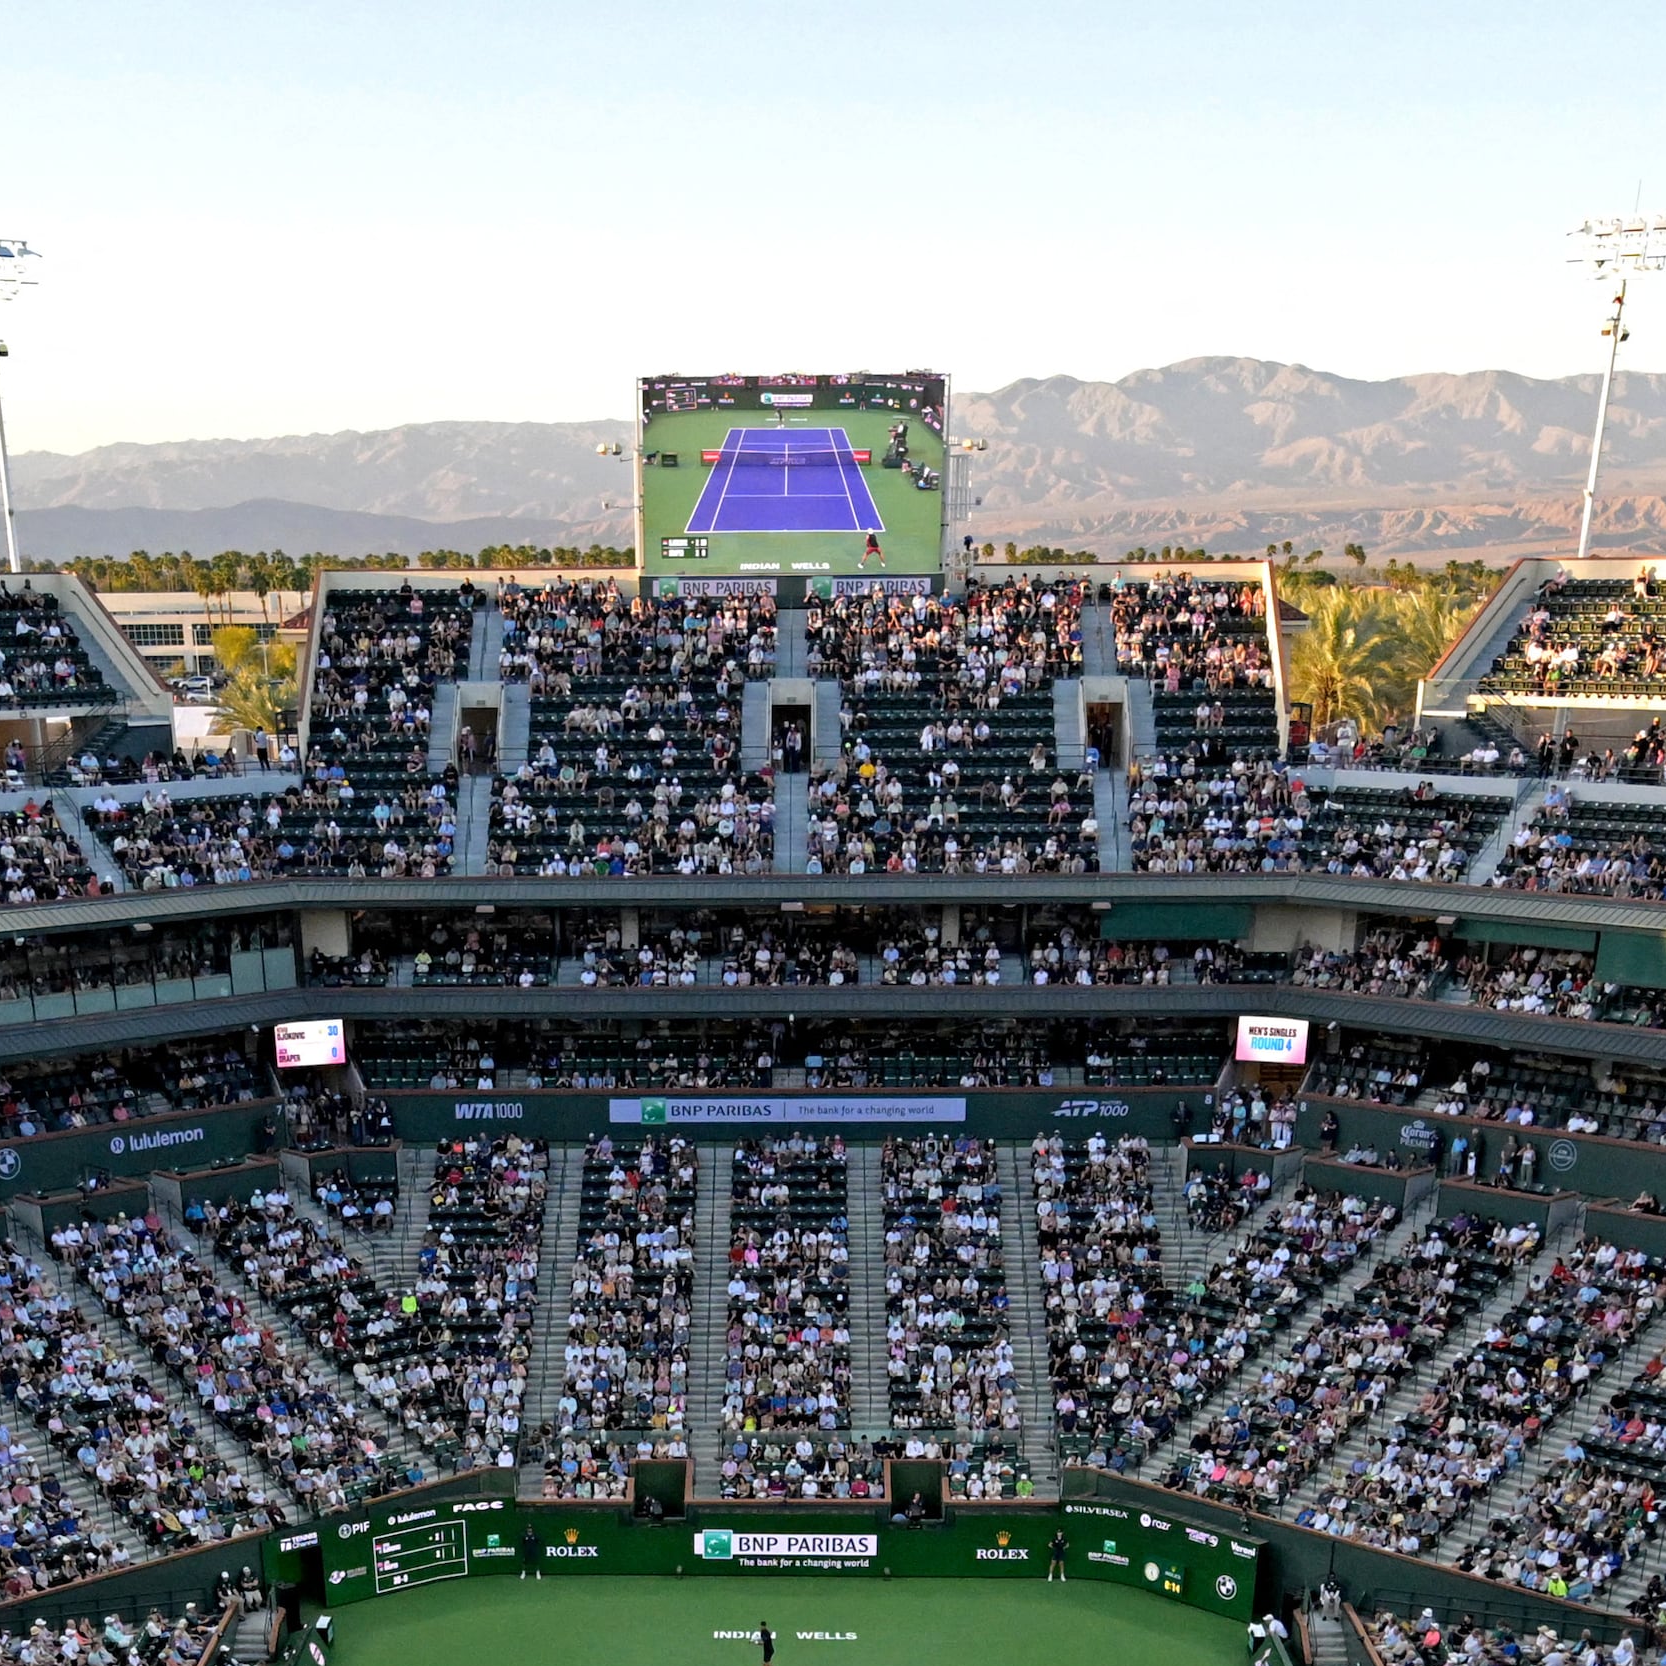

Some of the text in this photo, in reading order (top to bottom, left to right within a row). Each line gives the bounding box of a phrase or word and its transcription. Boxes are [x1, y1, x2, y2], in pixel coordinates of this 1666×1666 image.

[740, 562, 830, 570] INDIAN WELLS
[683, 582, 772, 595] BNP PARIBAS
[836, 581, 863, 593] BNP
[327, 1025, 339, 1036] 30
[1249, 1026, 1297, 1038] MEN'S SINGLES
[1251, 1036, 1292, 1052] ROUND 4
[332, 1047, 337, 1058] 0
[1205, 1094, 1212, 1105] 8
[276, 1104, 282, 1115] 7
[671, 1104, 772, 1117] BNP PARIBAS
[798, 1106, 814, 1115] The
[817, 1106, 837, 1115] bank
[841, 1106, 855, 1117] for
[865, 1106, 910, 1117] changing
[913, 1106, 934, 1115] world
[1051, 1100, 1099, 1117] ATP
[1099, 1105, 1129, 1117] 1000
[1300, 1101, 1307, 1112] 8
[129, 1128, 204, 1151] lululemon
[397, 1509, 436, 1524] lululemon
[1073, 1505, 1129, 1519] SILVERSEA
[352, 1521, 371, 1535] PIF
[1151, 1519, 1172, 1531] razr
[738, 1536, 869, 1552] BNP PARIBAS
[546, 1546, 598, 1557] ROLEX
[976, 1549, 1029, 1560] ROLEX
[738, 1558, 755, 1567] The
[757, 1558, 778, 1567] bank
[779, 1558, 793, 1569] for
[803, 1558, 841, 1569] changing
[843, 1558, 869, 1568] world
[796, 1631, 858, 1640] WELLS
